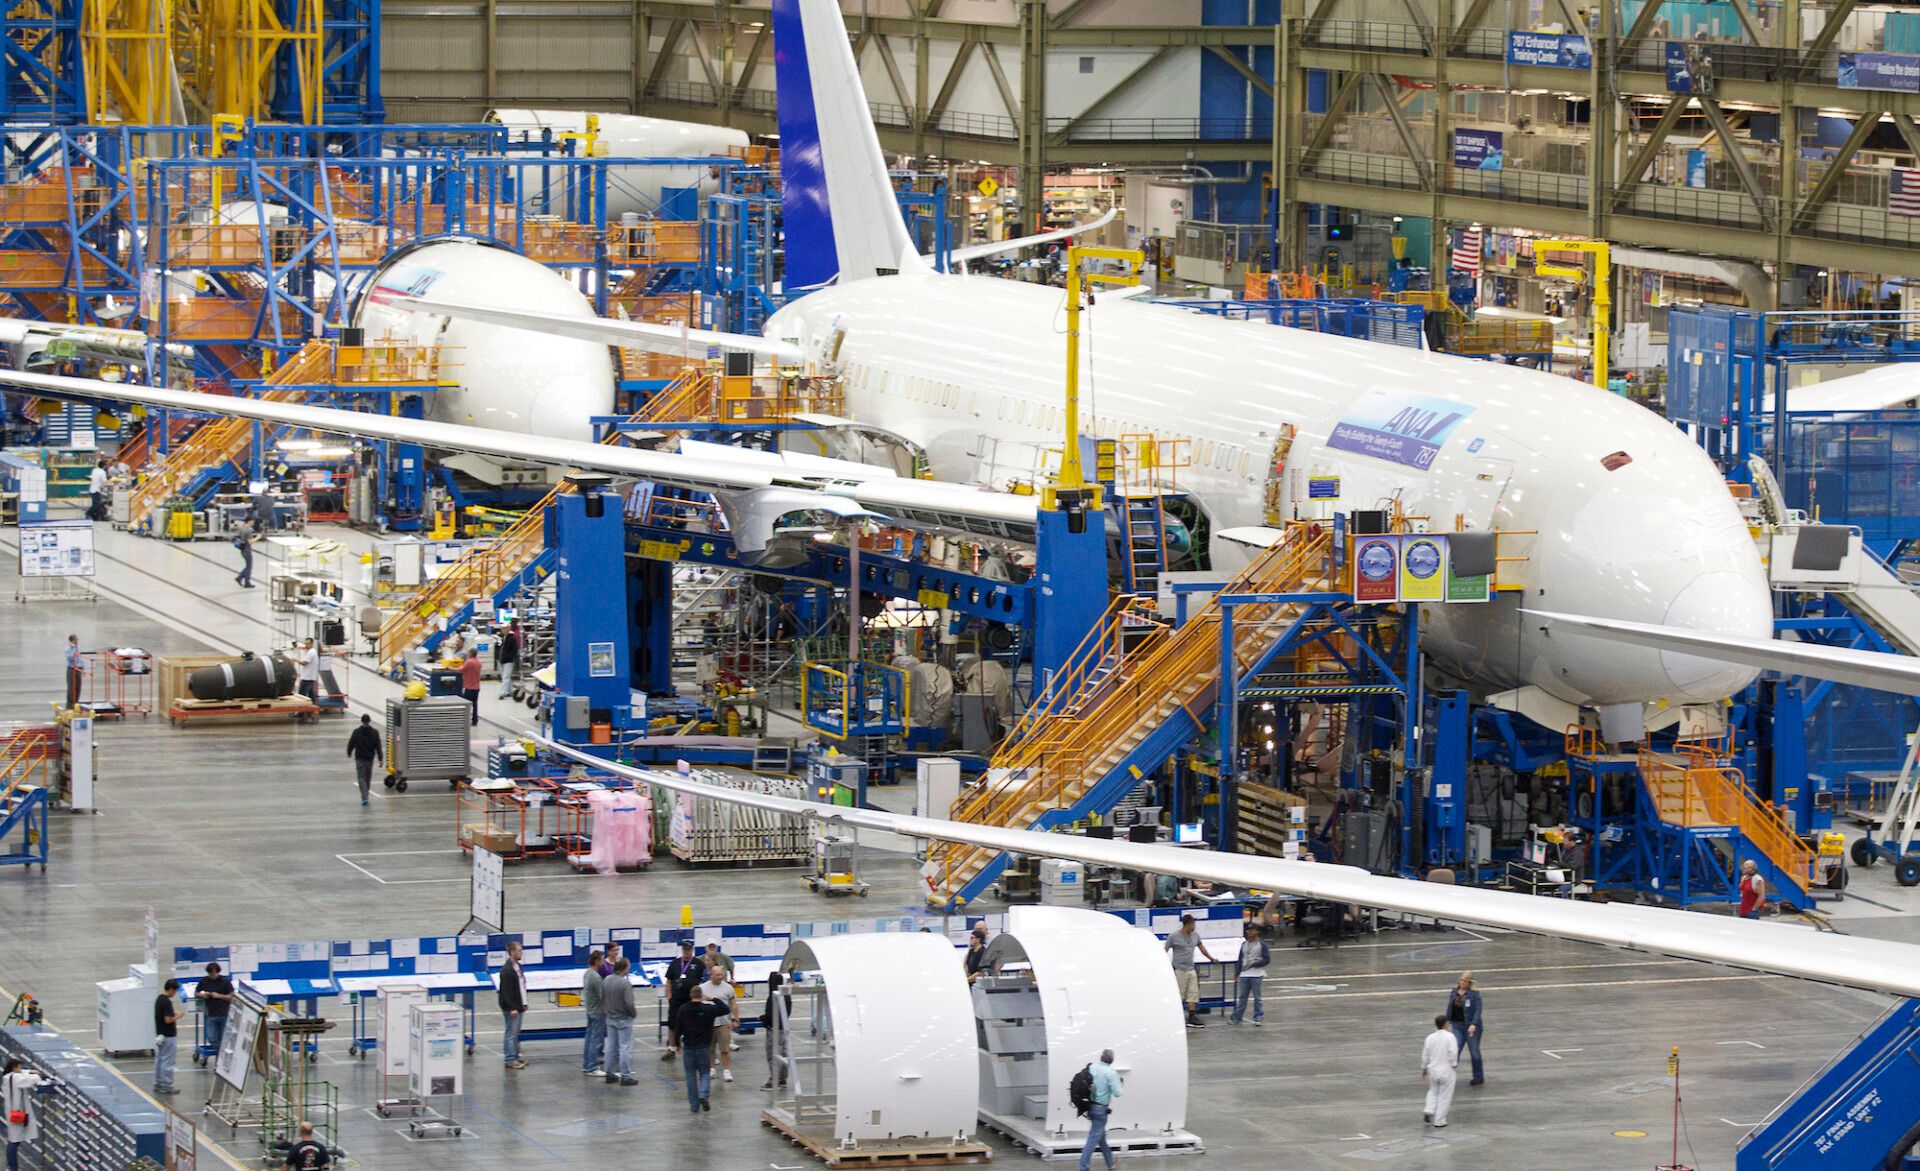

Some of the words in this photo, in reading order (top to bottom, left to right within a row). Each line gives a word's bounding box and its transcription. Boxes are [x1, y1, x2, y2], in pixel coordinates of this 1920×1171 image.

[1512, 36, 1524, 47] 787
[1526, 36, 1560, 50] Enhanced
[1513, 48, 1538, 64] Training
[1538, 50, 1558, 62] Center
[1381, 406, 1438, 438] ANA
[1414, 446, 1438, 465] 787
[1814, 1135, 1826, 1148] 787
[1826, 1120, 1846, 1136] FINAL
[1846, 1088, 1878, 1119] ASSEMBLY
[1819, 1140, 1834, 1154] PAX
[1833, 1121, 1856, 1141] STAND
[1854, 1106, 1870, 1122] UNIT
